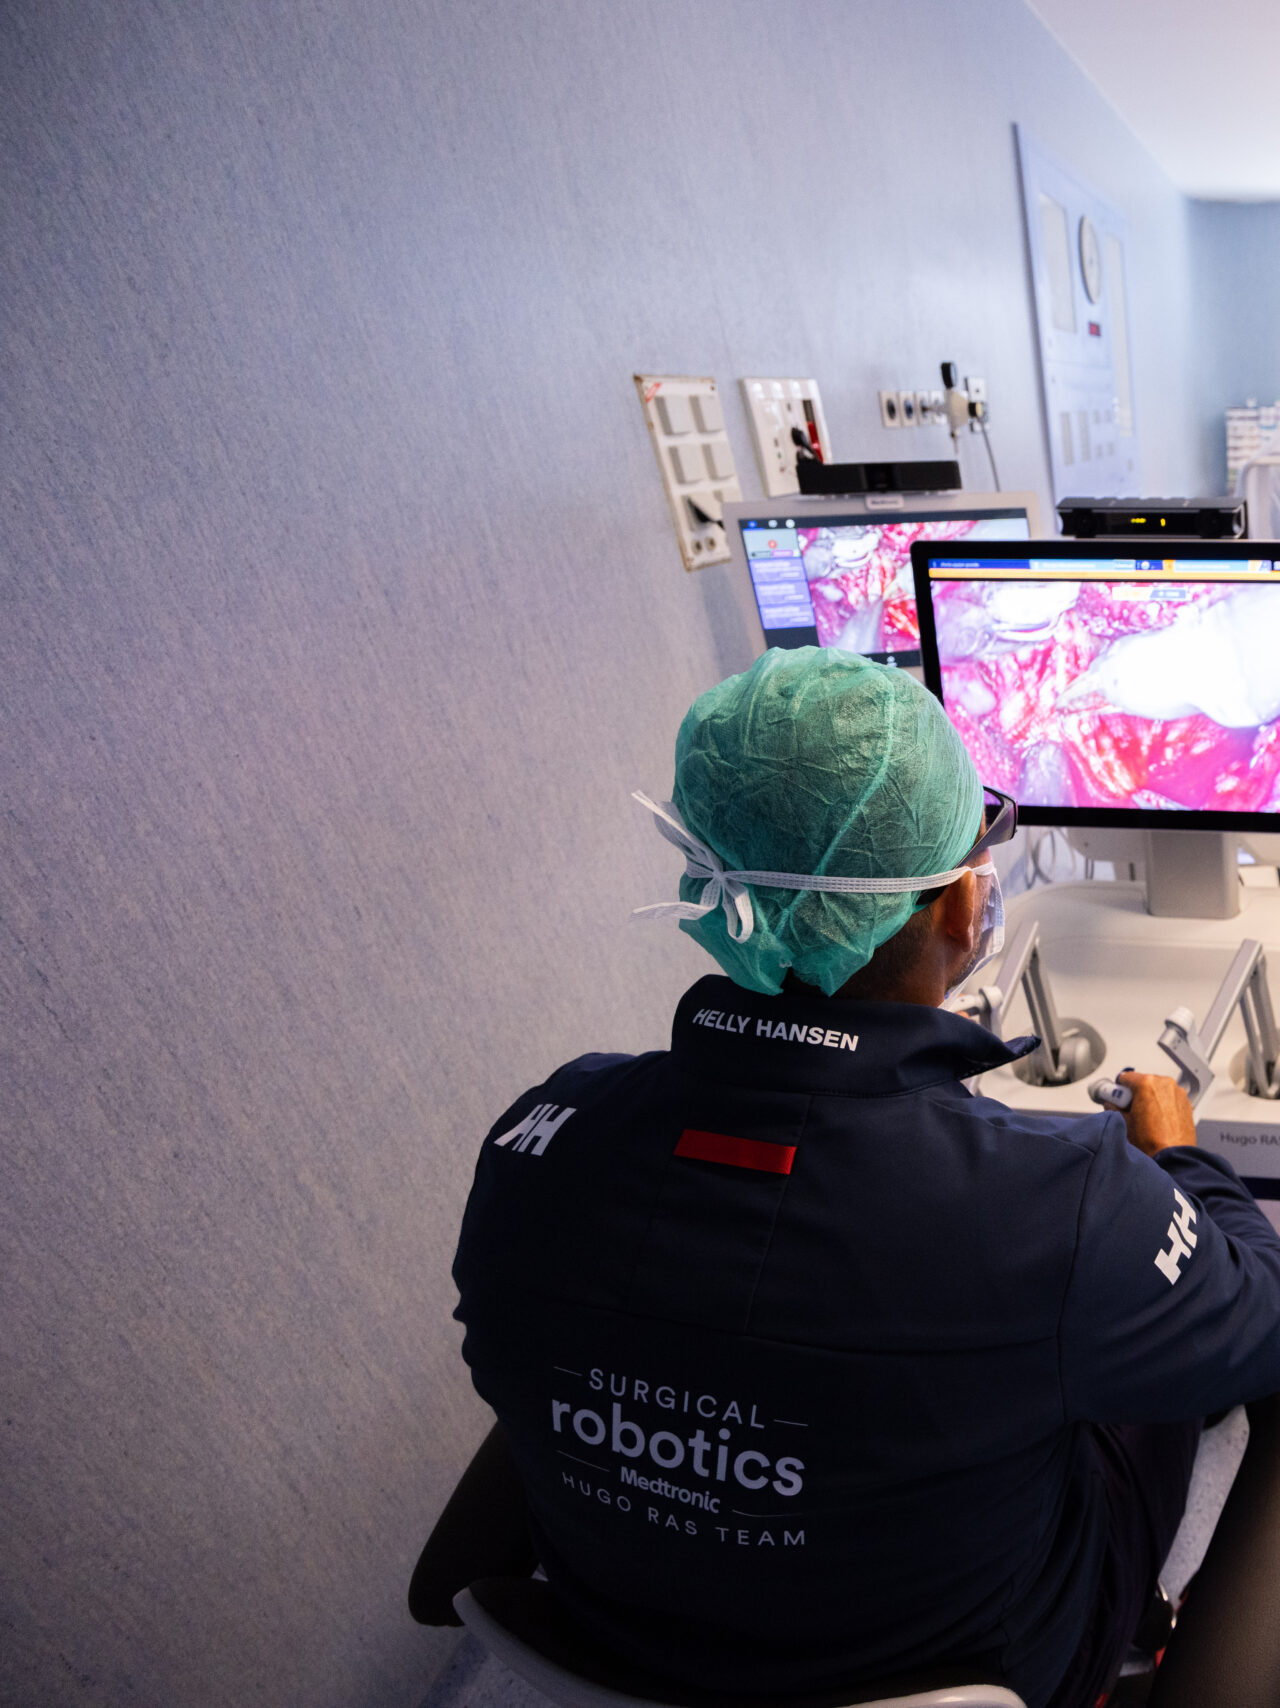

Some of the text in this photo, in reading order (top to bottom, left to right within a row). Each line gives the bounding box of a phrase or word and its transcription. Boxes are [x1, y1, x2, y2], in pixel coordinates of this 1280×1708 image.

[692, 1008, 859, 1052] HELLY HANSEN
[1220, 1132, 1257, 1146] Hugo
[588, 1368, 765, 1429] SURGICAL
[552, 1399, 805, 1497] robotics
[562, 1471, 806, 1546] HUGO RAS TEAM
[620, 1466, 721, 1514] Medtronic
